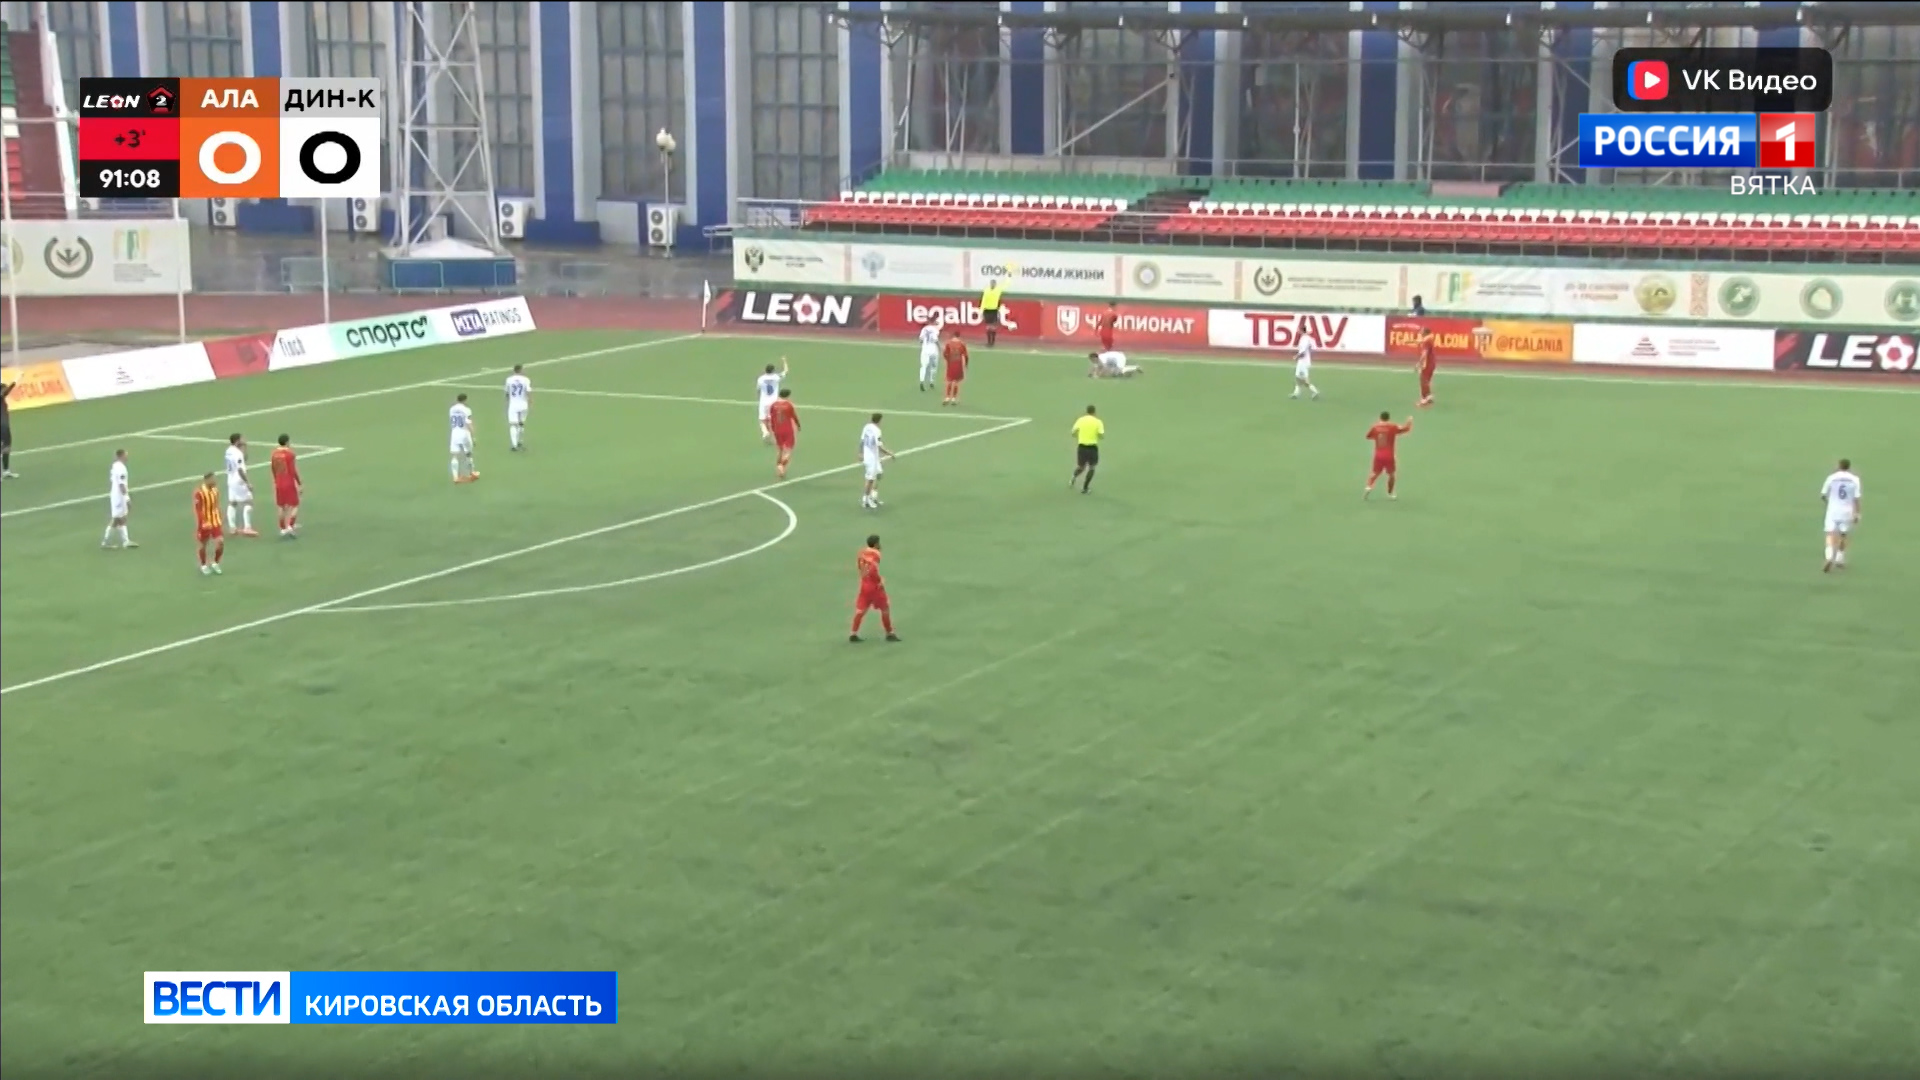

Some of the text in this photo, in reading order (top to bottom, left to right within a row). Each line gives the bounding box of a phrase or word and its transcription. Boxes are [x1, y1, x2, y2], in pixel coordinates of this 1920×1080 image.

[742, 291, 852, 324] LEON
[906, 299, 1012, 330] legalbt
[1085, 314, 1195, 334] ЧМПИОНАТ
[1806, 333, 1920, 371] LEO
[1838, 485, 1847, 500] 6
